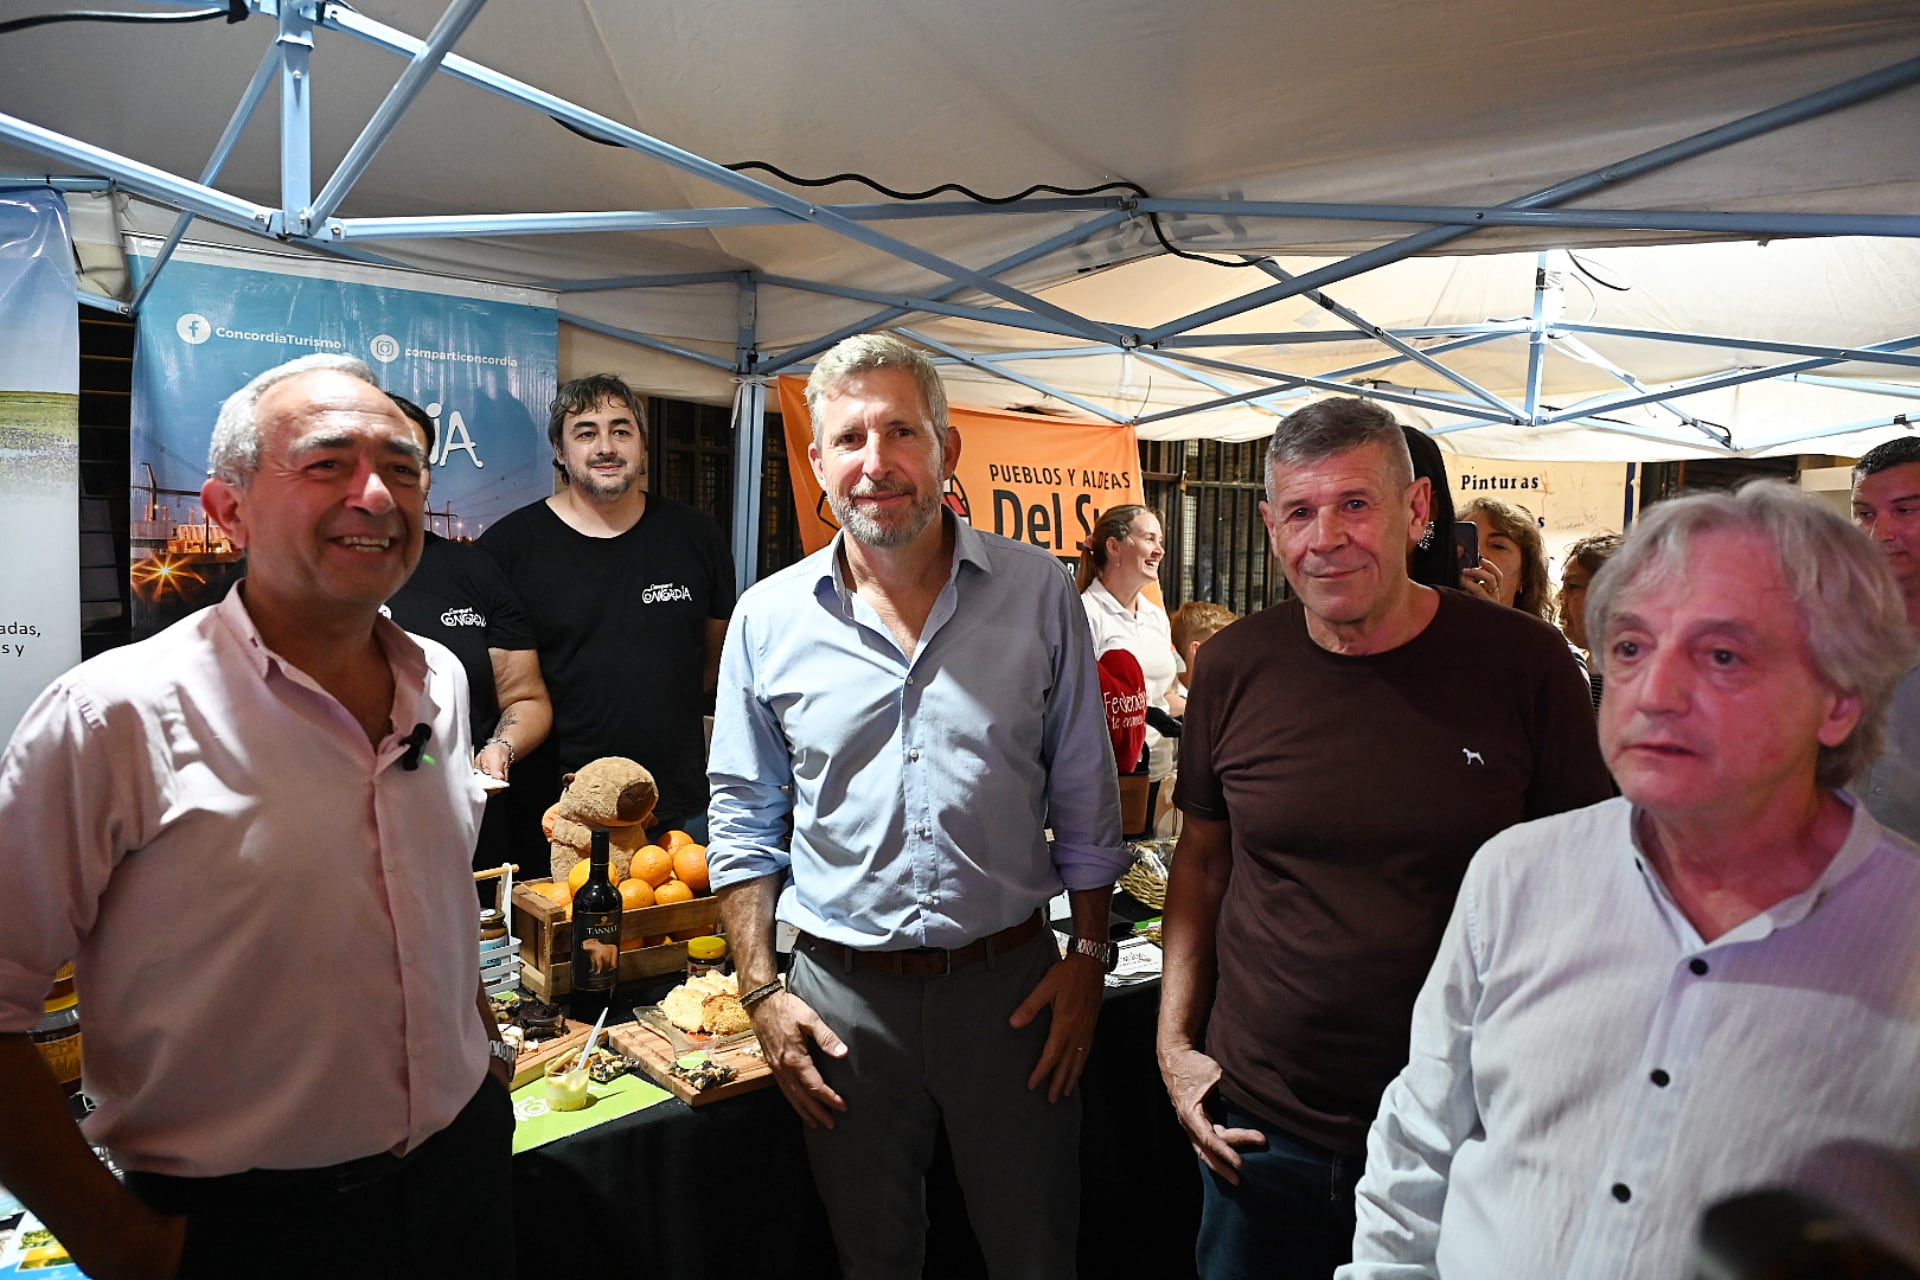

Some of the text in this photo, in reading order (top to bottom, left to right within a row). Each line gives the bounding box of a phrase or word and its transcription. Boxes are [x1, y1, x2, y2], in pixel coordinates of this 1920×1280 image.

[215, 326, 342, 349] ConcordiaTurismo
[404, 347, 518, 367] comparticoncordia
[989, 463, 1131, 490] PUEBLOS Y ALDEAS
[1460, 474, 1539, 490] Pinturas
[992, 488, 1100, 552] Del S
[15, 644, 24, 658] y
